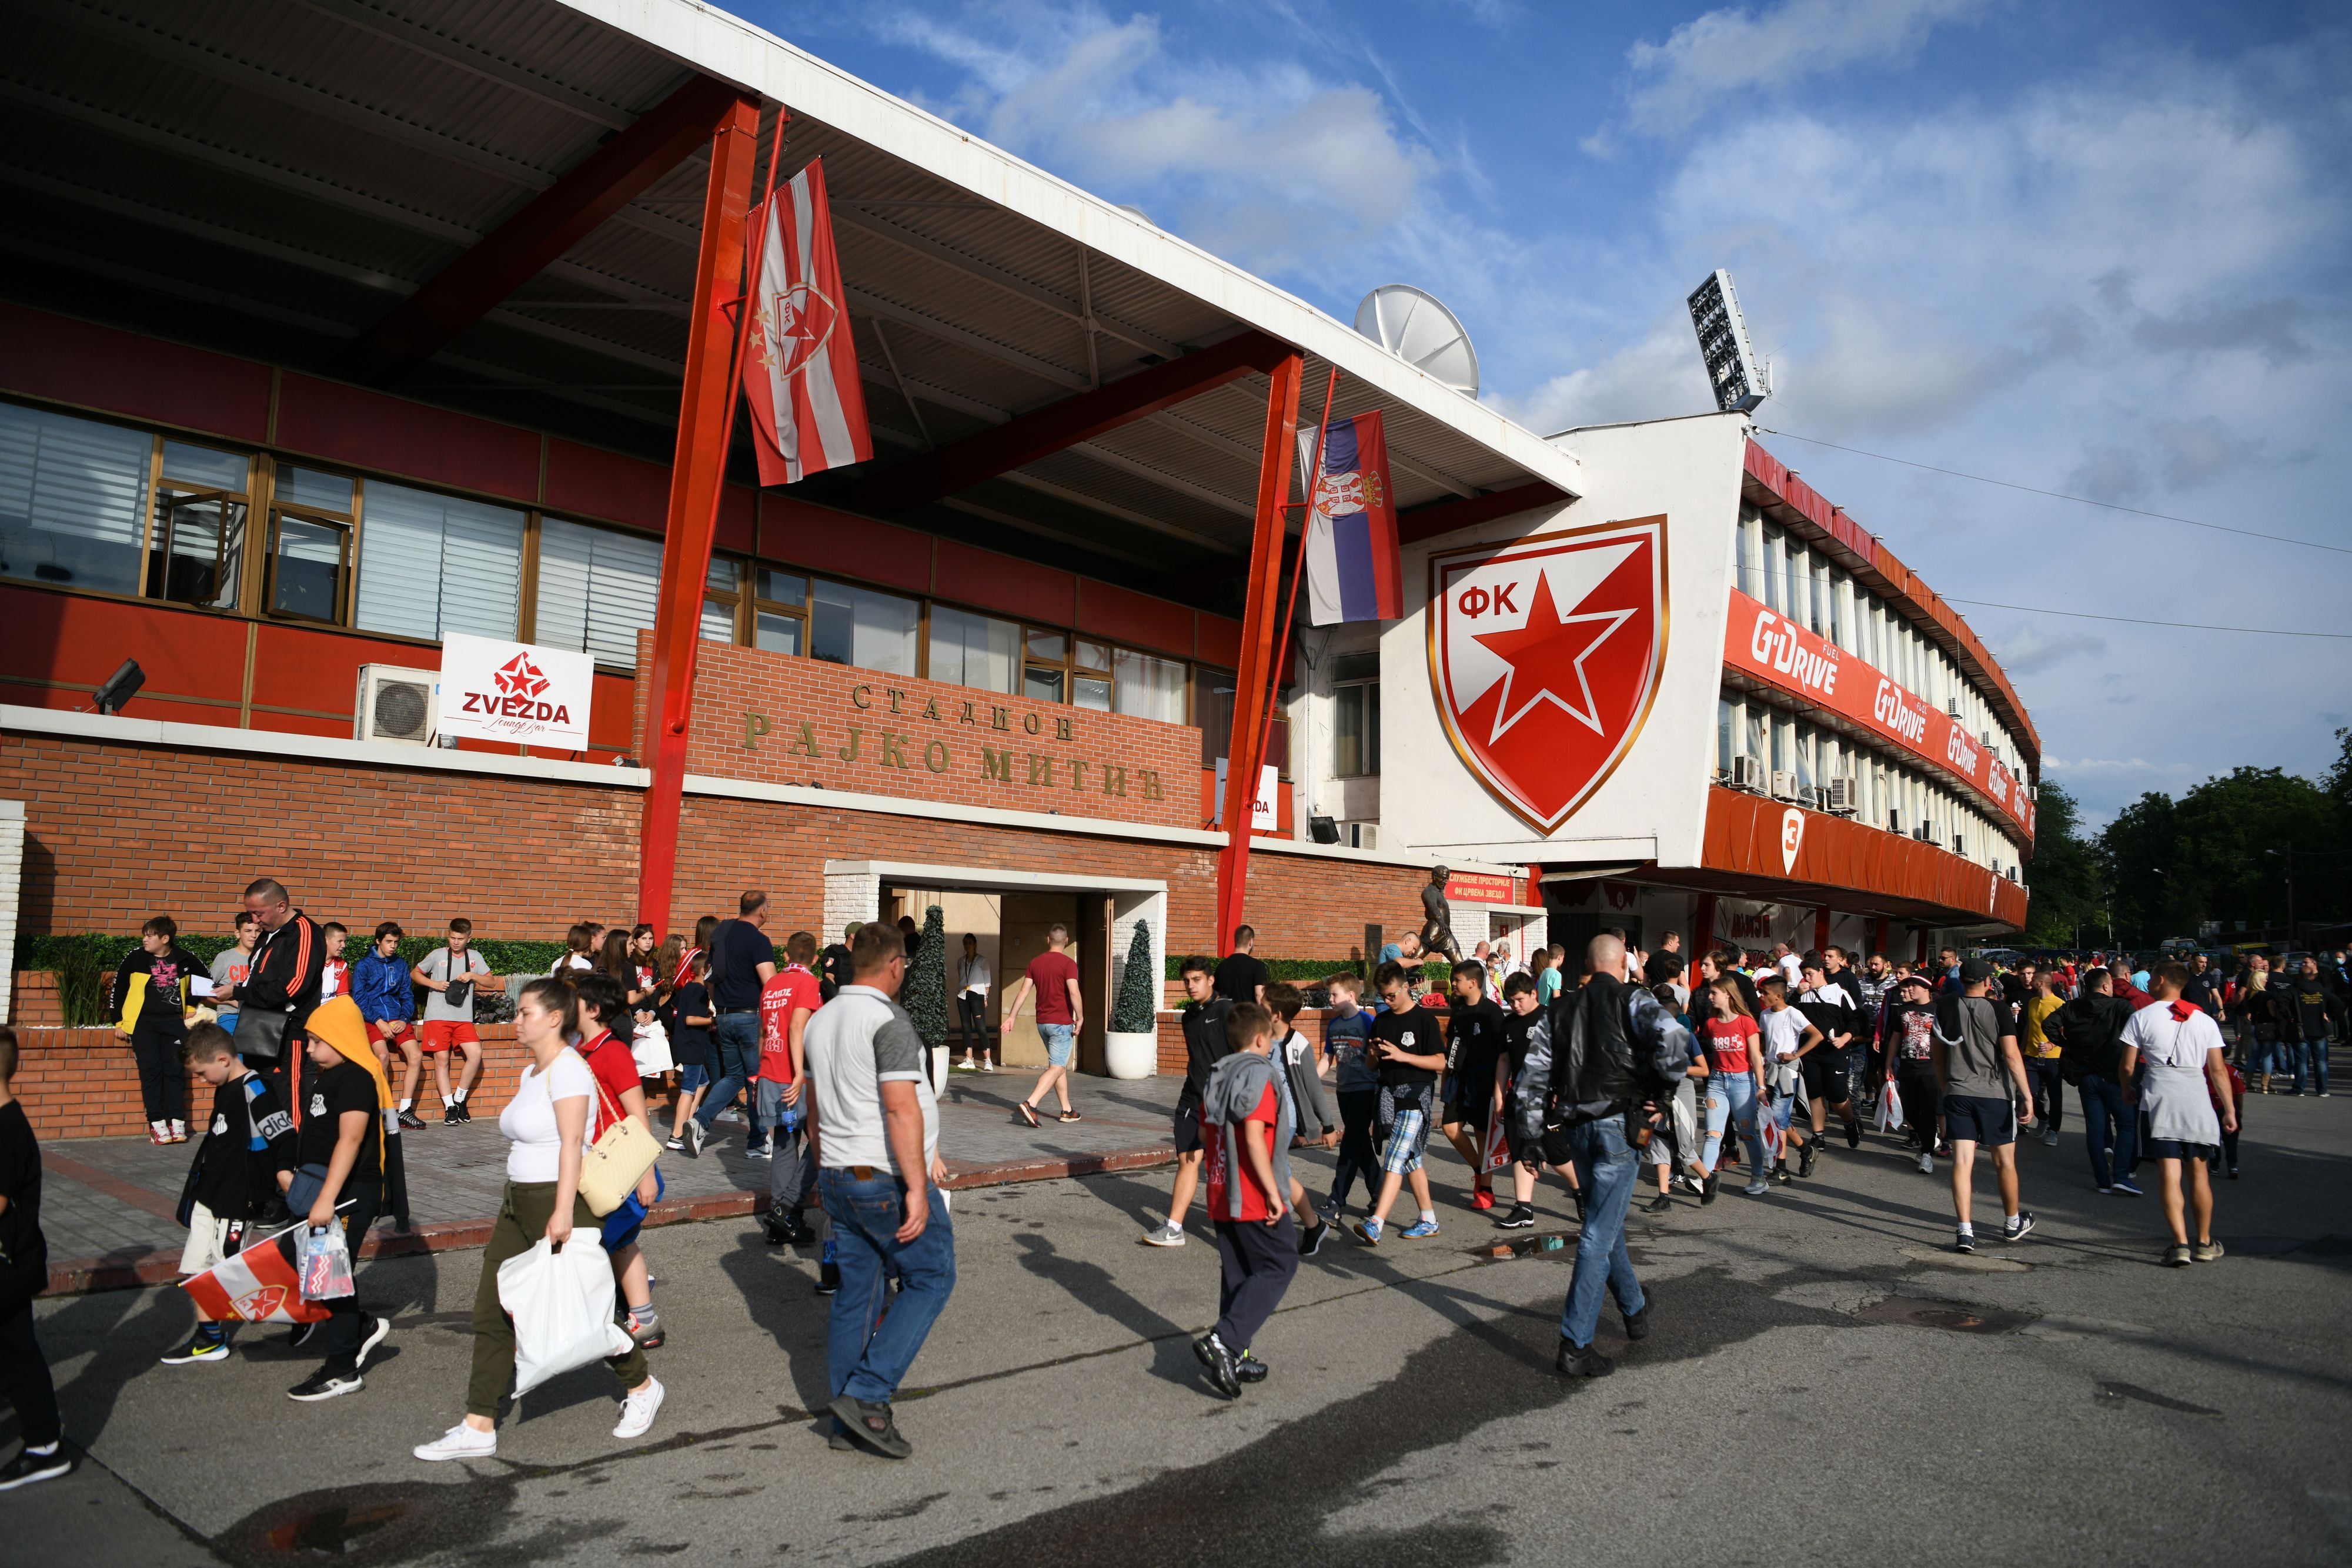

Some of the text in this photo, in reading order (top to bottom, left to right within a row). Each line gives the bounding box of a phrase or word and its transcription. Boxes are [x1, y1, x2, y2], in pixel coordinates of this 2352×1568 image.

[1458, 581, 1519, 618] ФК
[1823, 644, 1839, 661] FUEL
[462, 692, 570, 724] ZVEZDA
[854, 684, 1073, 741] СТАДИОН
[482, 717, 546, 737] Lounge Bar
[741, 711, 1164, 800] РАЈКО МИТИЋ
[1786, 819, 1799, 851] 3
[1449, 873, 1511, 887] СЛУЖБЕНЕ ПРОСТОРИЈЕ
[1454, 887, 1505, 900] ФК ЦРВЕНА ЗВЕЗДА
[1502, 927, 1506, 935] 1
[1712, 1036, 1730, 1049] 989
